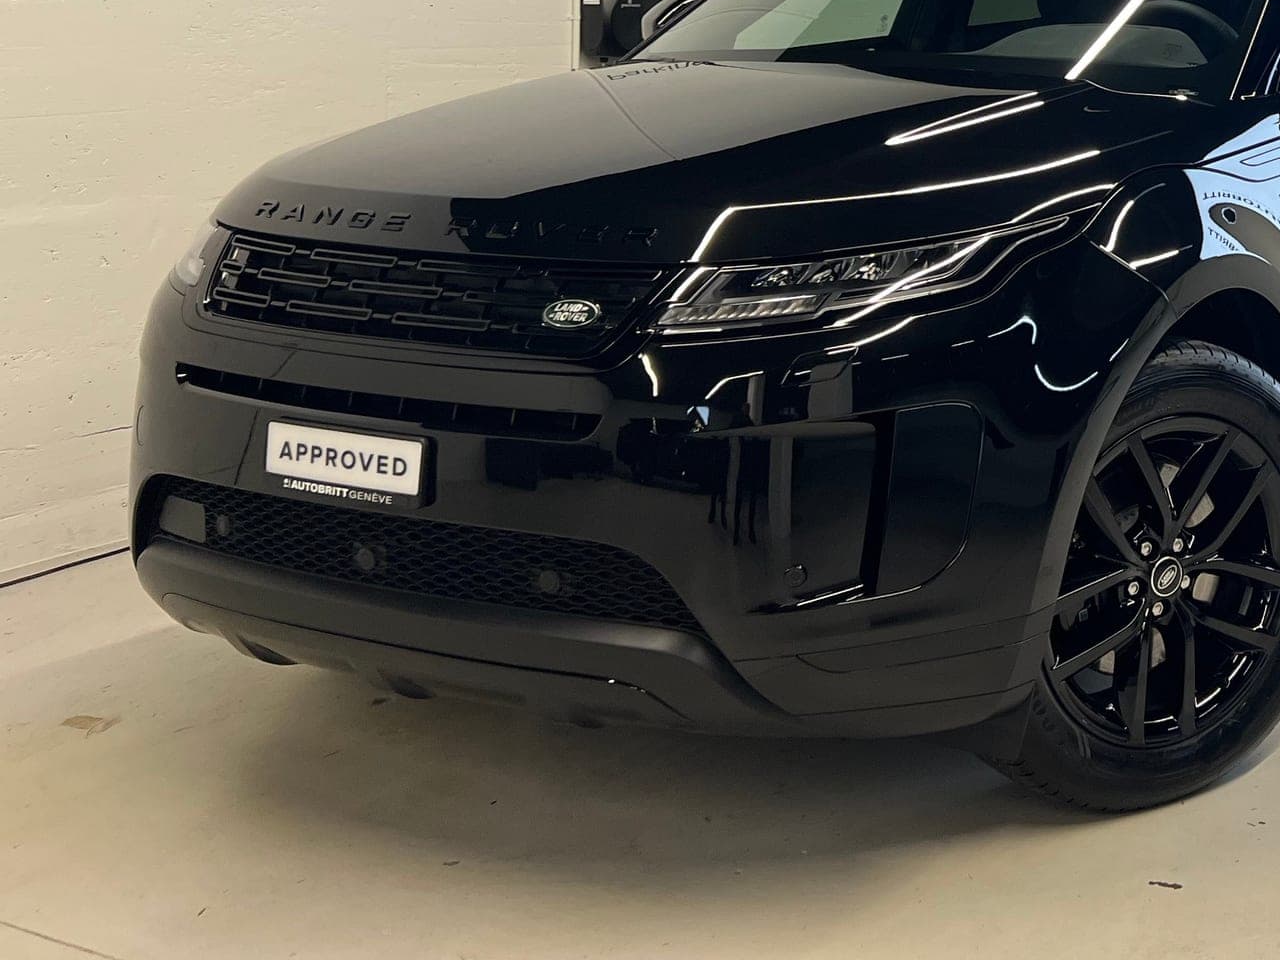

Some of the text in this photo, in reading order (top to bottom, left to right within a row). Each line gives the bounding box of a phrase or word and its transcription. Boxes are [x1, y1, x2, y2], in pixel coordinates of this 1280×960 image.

[254, 200, 412, 233] RANGE
[553, 312, 588, 322] ROVER
[554, 303, 583, 312] LAND
[279, 441, 407, 476] APPROVED
[291, 478, 349, 499] AUTOBRITT
